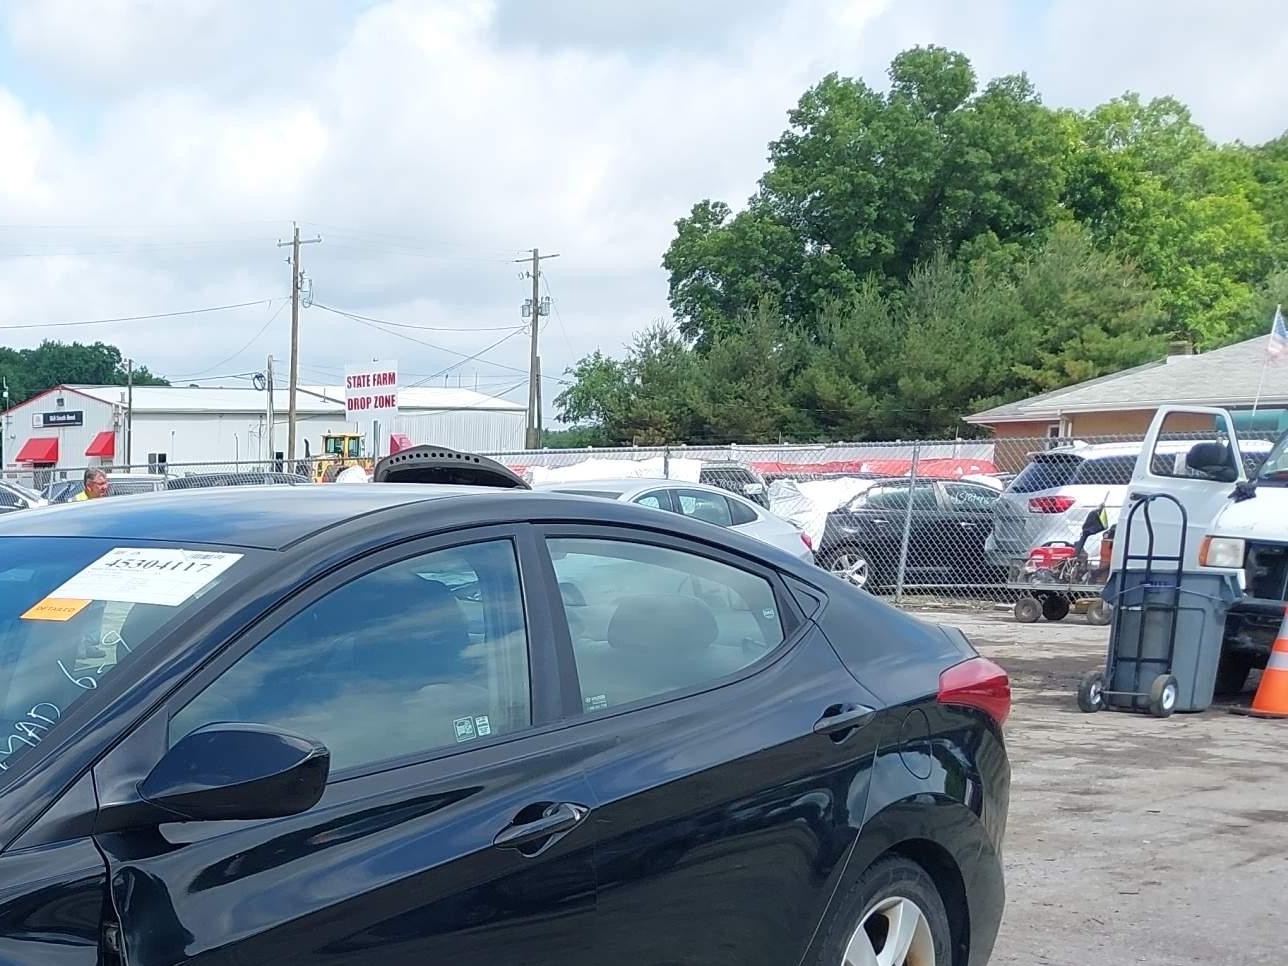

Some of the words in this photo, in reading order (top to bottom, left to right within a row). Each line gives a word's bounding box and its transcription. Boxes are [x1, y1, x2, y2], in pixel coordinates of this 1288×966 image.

[346, 374, 371, 389] STATE
[372, 371, 396, 387] FARM
[347, 396, 372, 411] DROP
[373, 394, 396, 409] ZONE
[105, 557, 212, 573] 45304117
